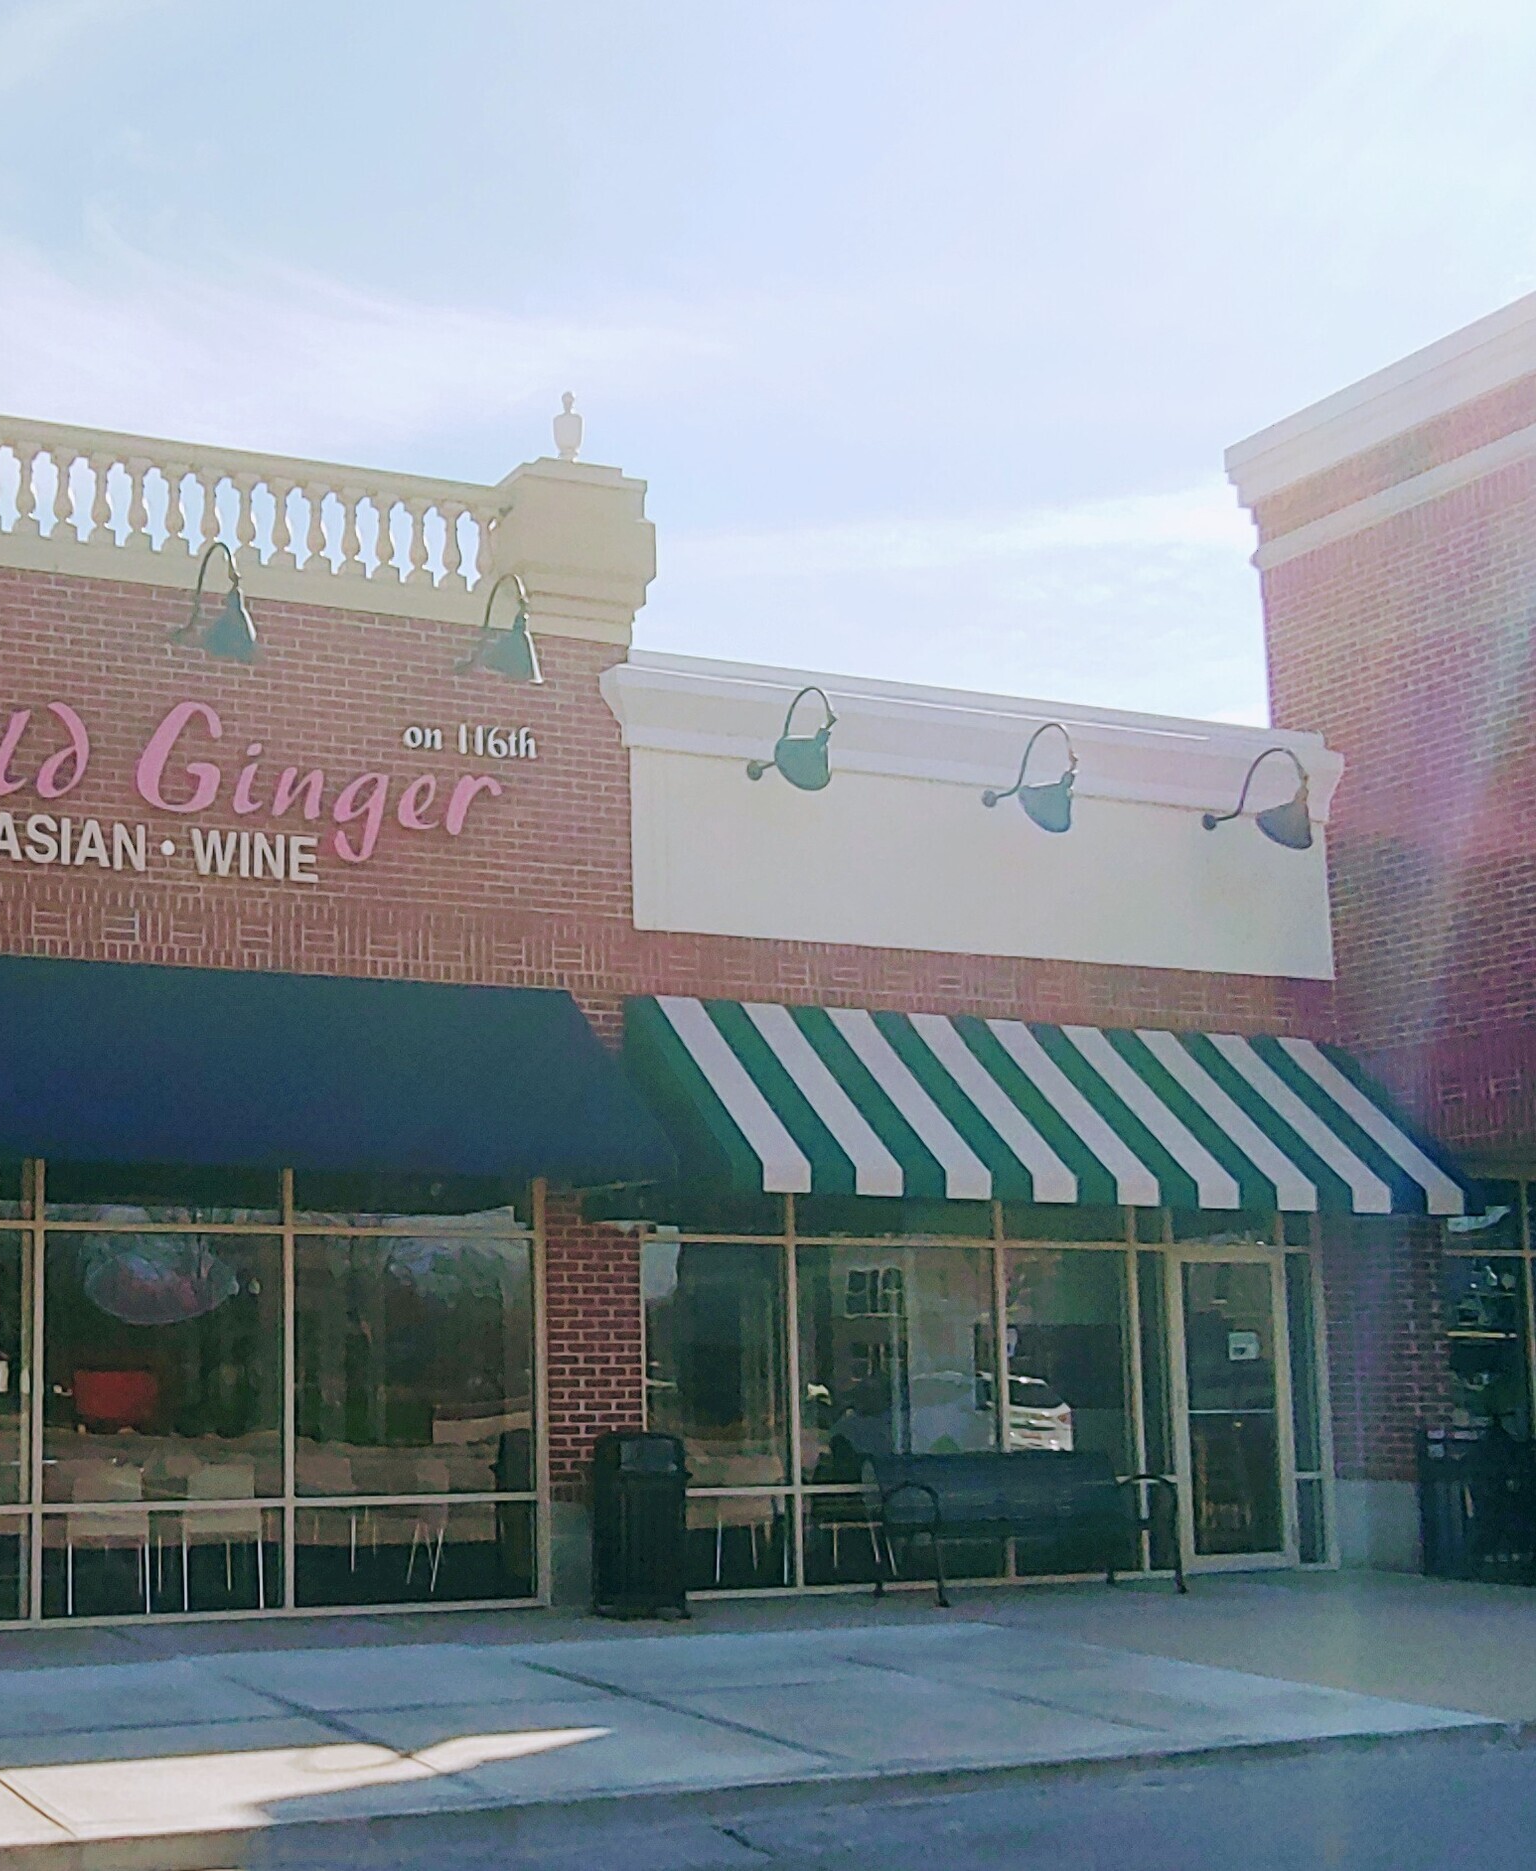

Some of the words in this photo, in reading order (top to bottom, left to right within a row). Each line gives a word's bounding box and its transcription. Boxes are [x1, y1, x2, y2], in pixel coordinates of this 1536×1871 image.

[402, 726, 443, 751] on
[457, 723, 538, 760] 116th
[136, 701, 503, 862] Ginger
[191, 828, 320, 884] WINE
